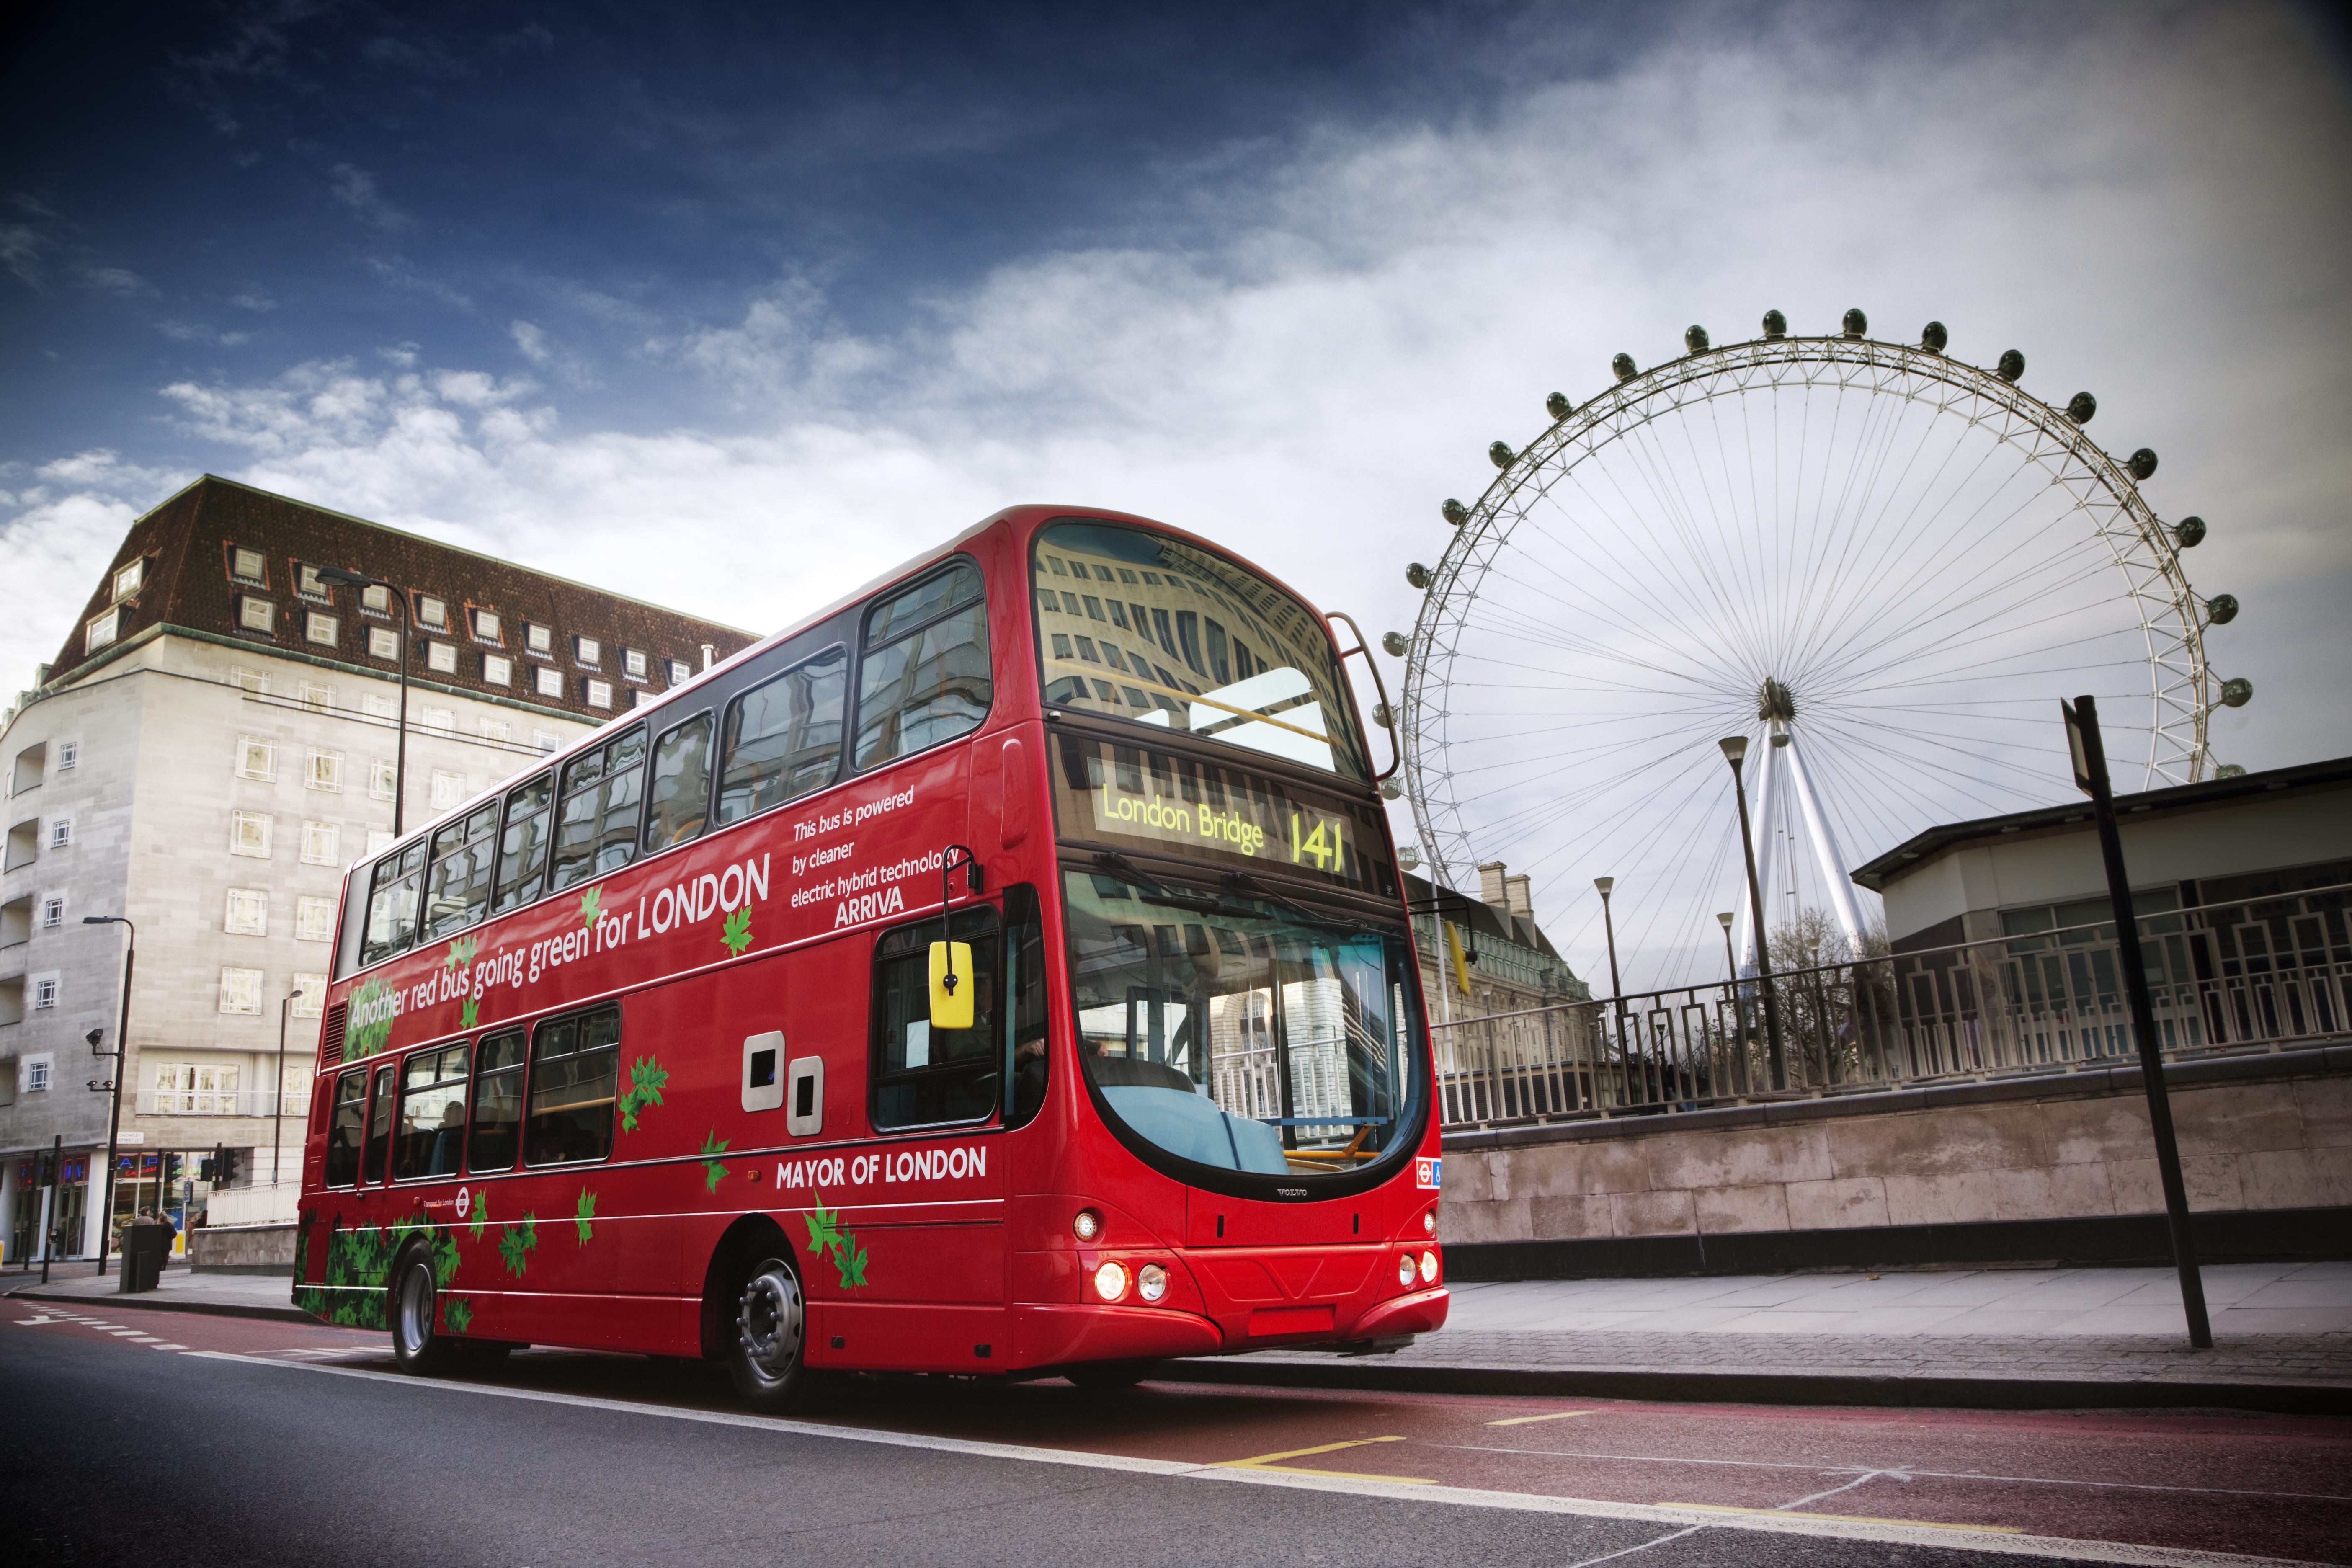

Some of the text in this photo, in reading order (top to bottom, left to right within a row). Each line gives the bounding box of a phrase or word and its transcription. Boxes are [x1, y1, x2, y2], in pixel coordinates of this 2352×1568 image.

[794, 784, 915, 842] This bus is powered
[1102, 783, 1264, 856] London Bridge
[792, 842, 854, 877] by cleaner
[1291, 812, 1342, 872] 141
[791, 879, 835, 908] electric
[838, 866, 877, 898] hybrid
[834, 885, 904, 928] ARRIVA
[350, 852, 770, 1030] Another red bus going green for LONDON
[776, 1146, 986, 1189] MAYOR OF LONDON
